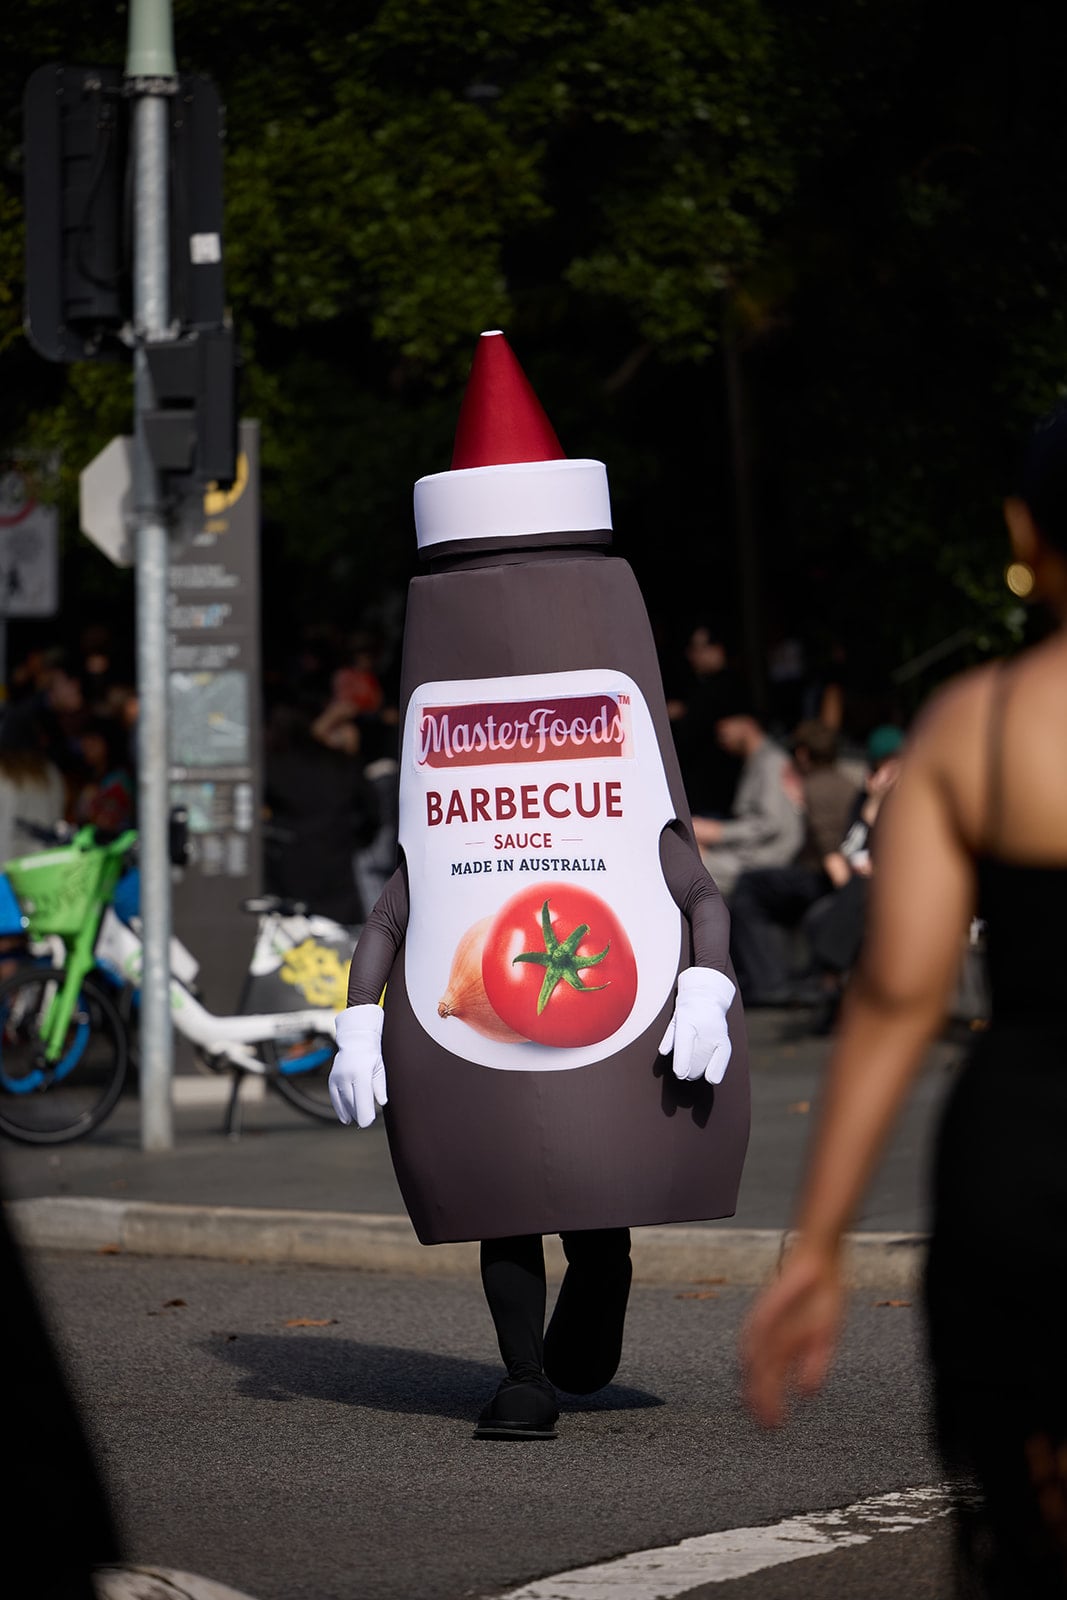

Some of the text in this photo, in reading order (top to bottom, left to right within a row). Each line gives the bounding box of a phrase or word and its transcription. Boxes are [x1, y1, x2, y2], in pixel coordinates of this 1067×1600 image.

[418, 705, 625, 765] MasterFoods
[426, 781, 623, 826] BARBECUE
[494, 833, 552, 850] SAUCE
[451, 859, 607, 876] MADE IN AUSTRALIA
